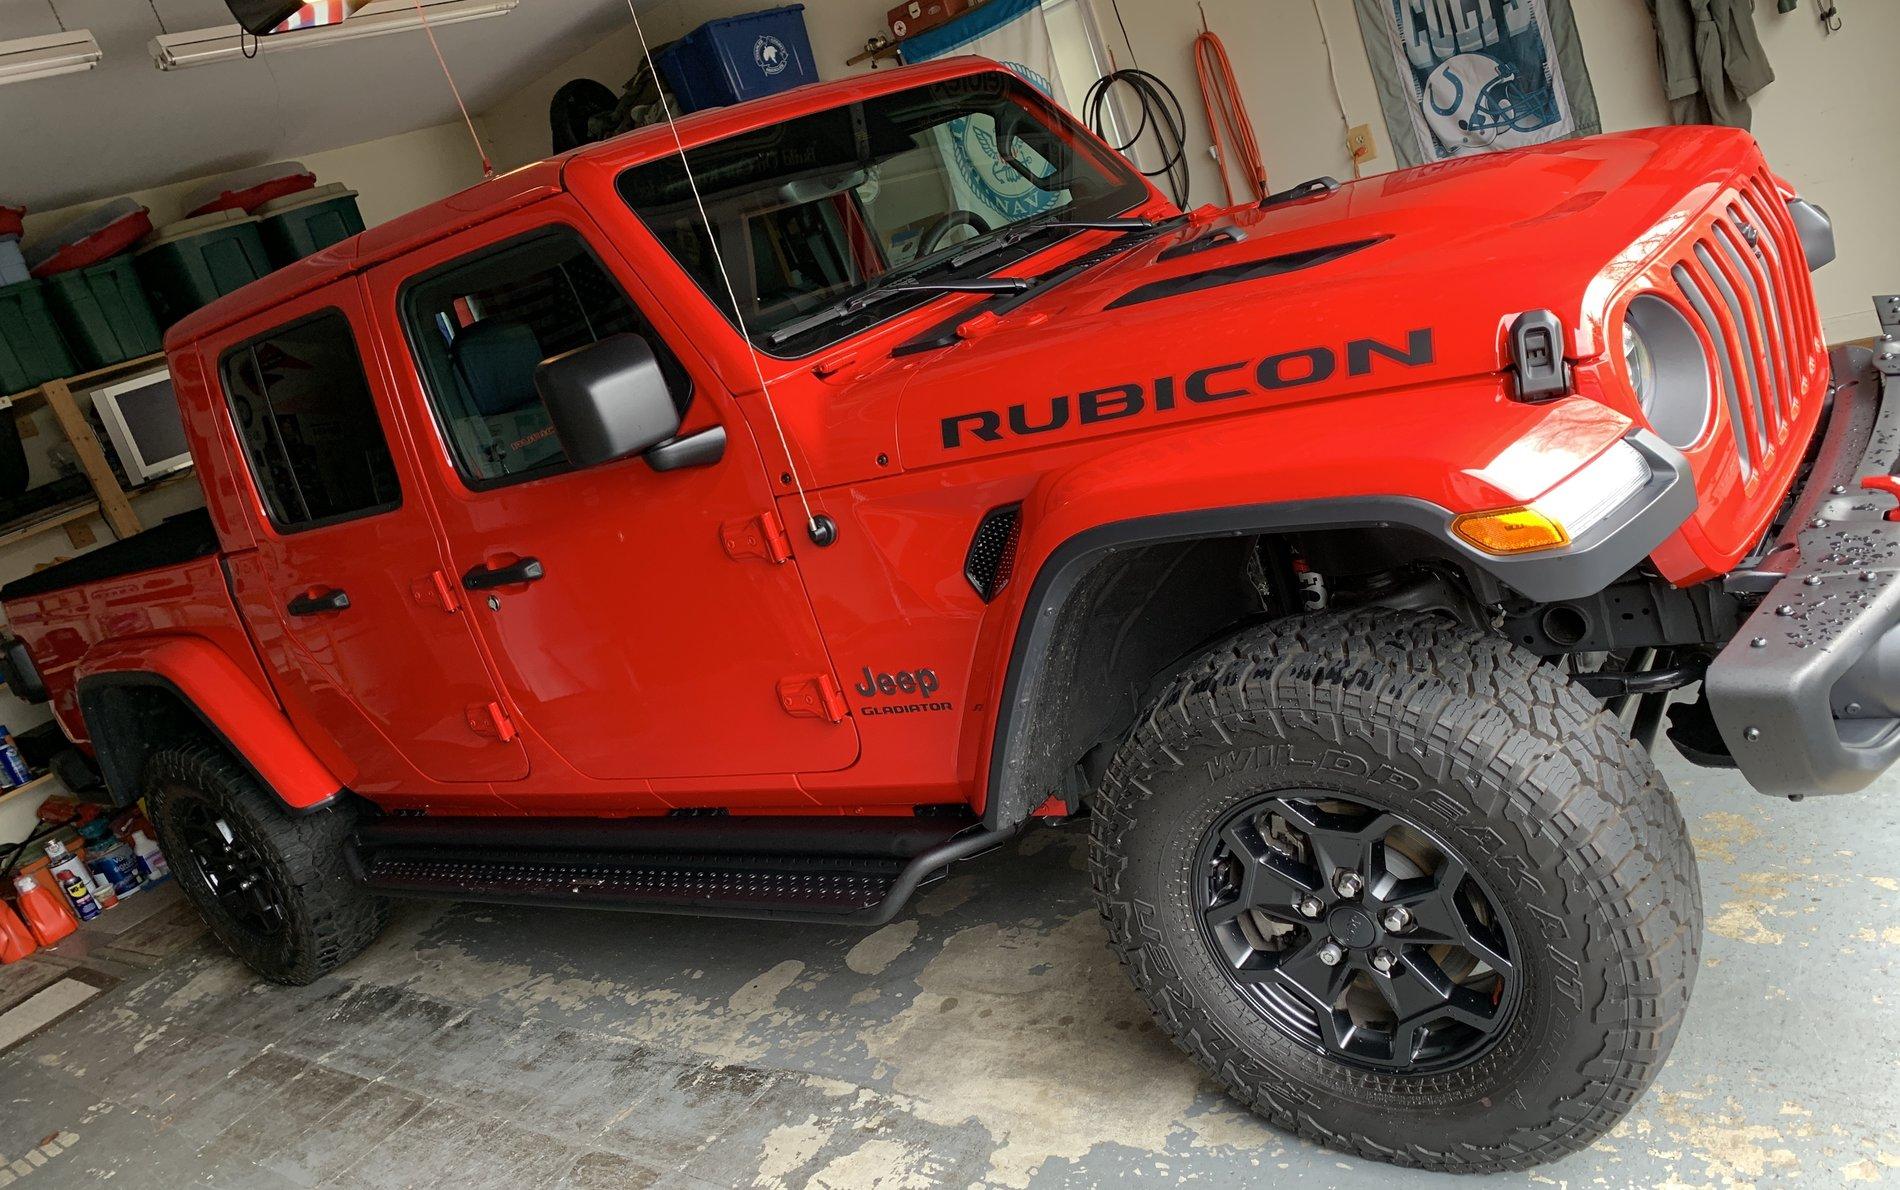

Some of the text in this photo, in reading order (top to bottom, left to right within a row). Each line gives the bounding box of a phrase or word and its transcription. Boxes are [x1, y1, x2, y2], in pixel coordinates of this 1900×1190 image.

[995, 191, 1039, 215] NAV
[942, 327, 1433, 449] RUBICON
[855, 665, 939, 698] Jeep
[860, 702, 953, 716] GLADIATOR
[1202, 743, 1546, 896] WILDPEAK
